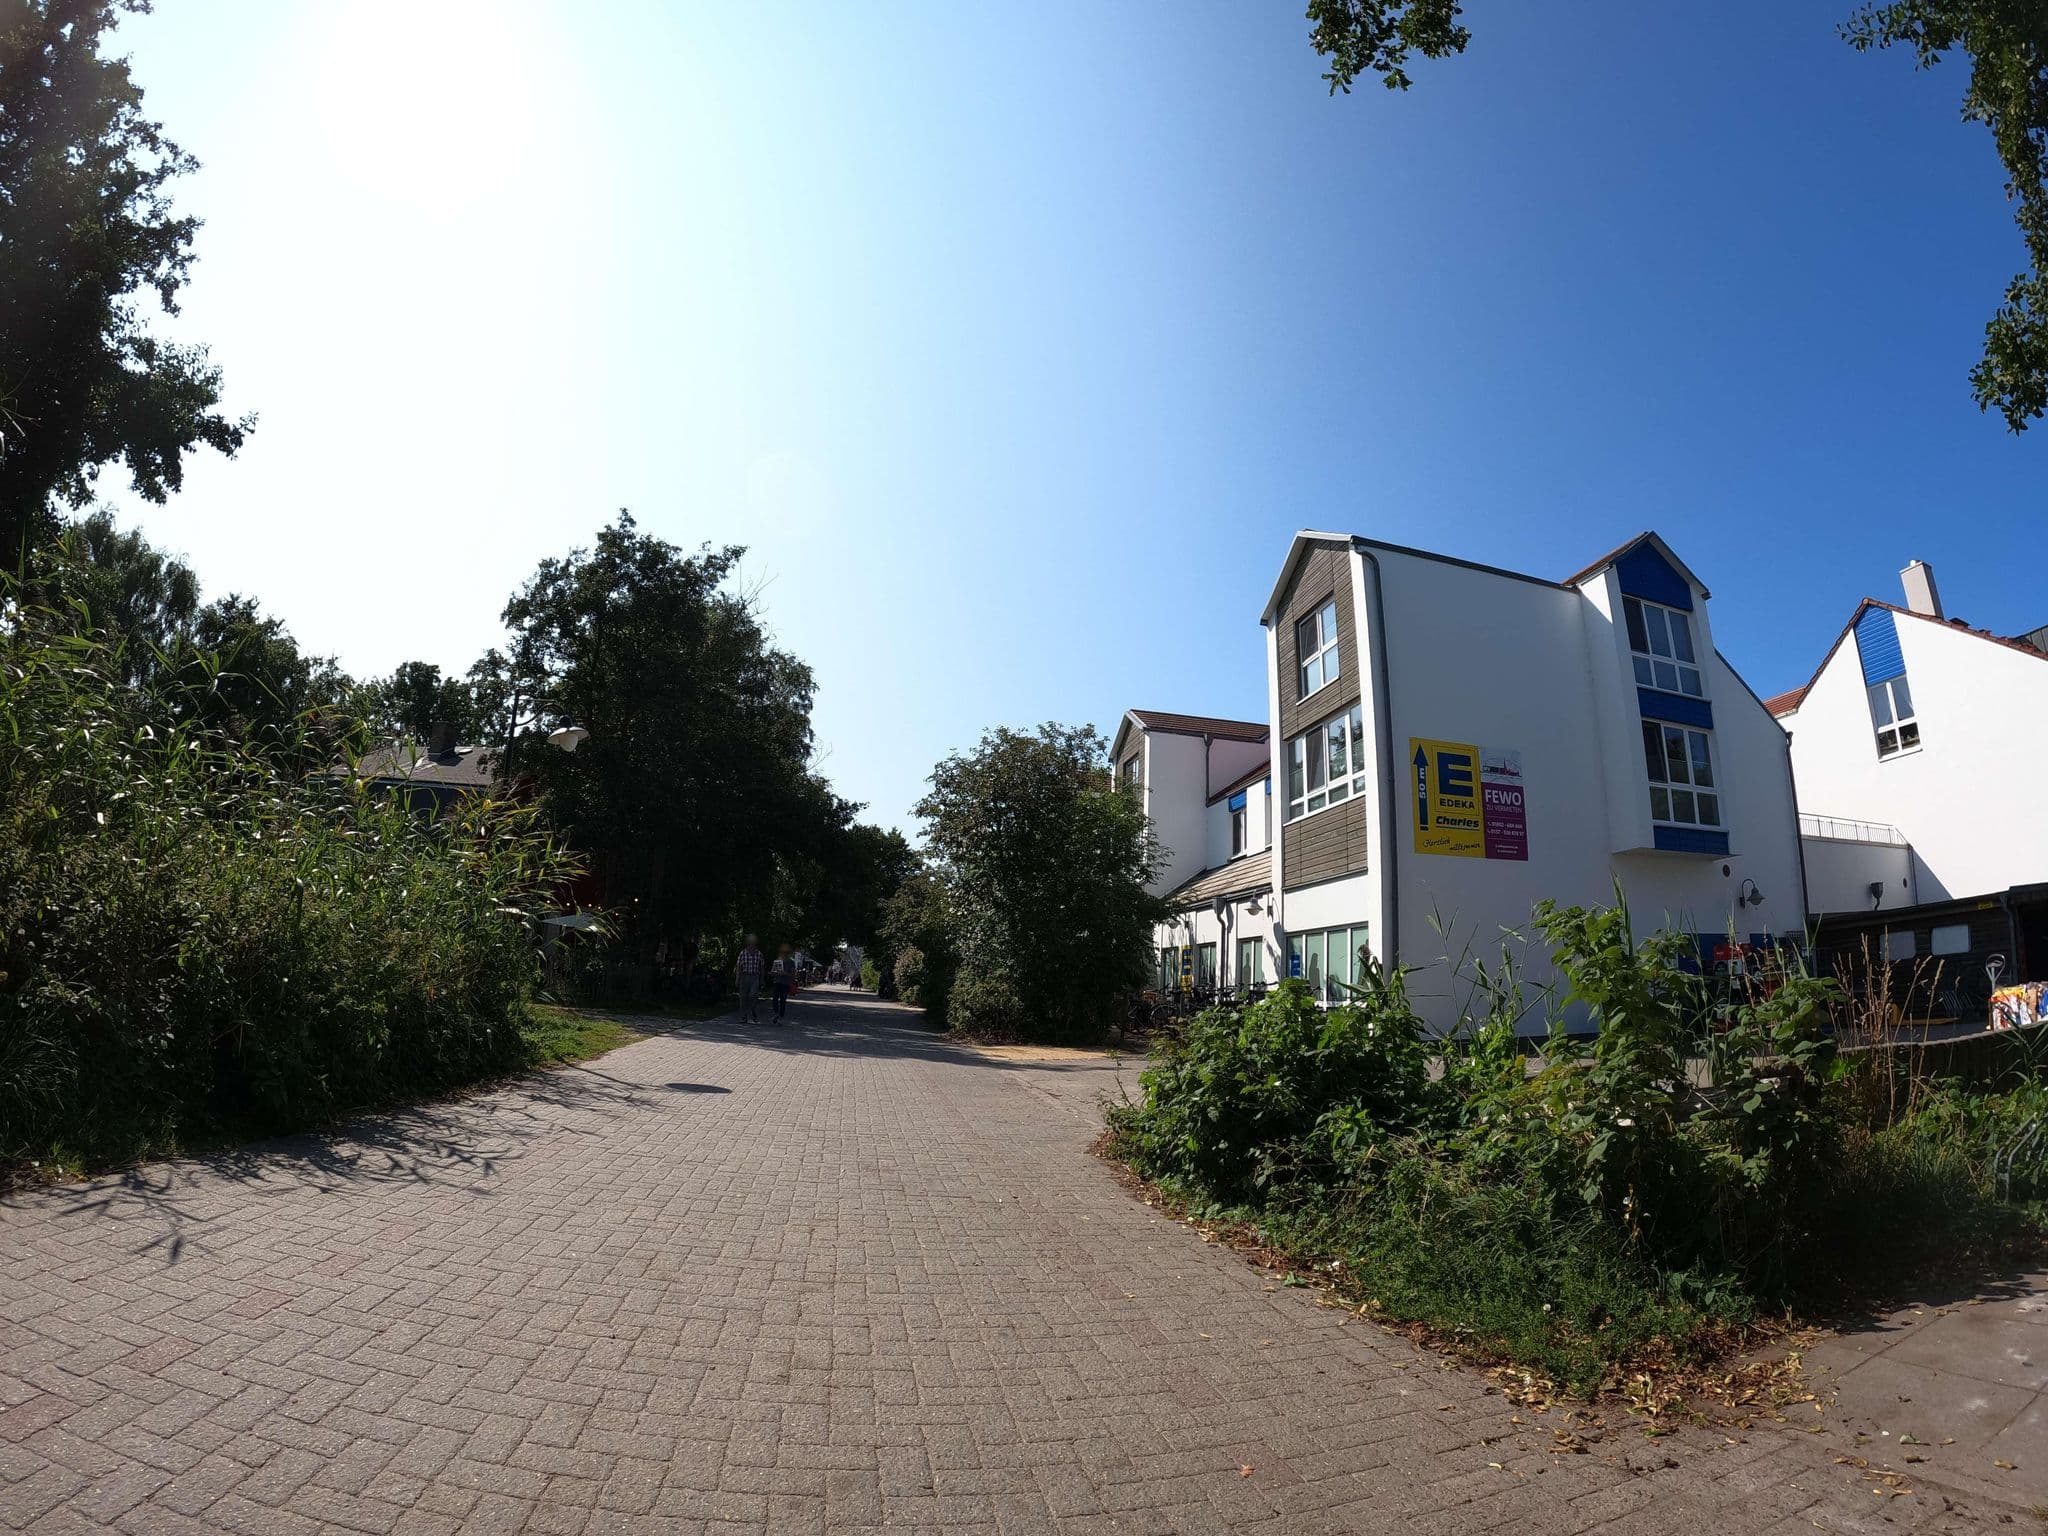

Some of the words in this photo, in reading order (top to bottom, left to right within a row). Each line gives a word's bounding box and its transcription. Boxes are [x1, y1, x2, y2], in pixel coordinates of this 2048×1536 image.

[1419, 768, 1425, 779] m
[1437, 752, 1473, 797] E
[1419, 783, 1426, 799] 50
[1485, 790, 1521, 805] FEWO
[1440, 798, 1475, 809] EDEKA
[1436, 816, 1479, 828] Charles
